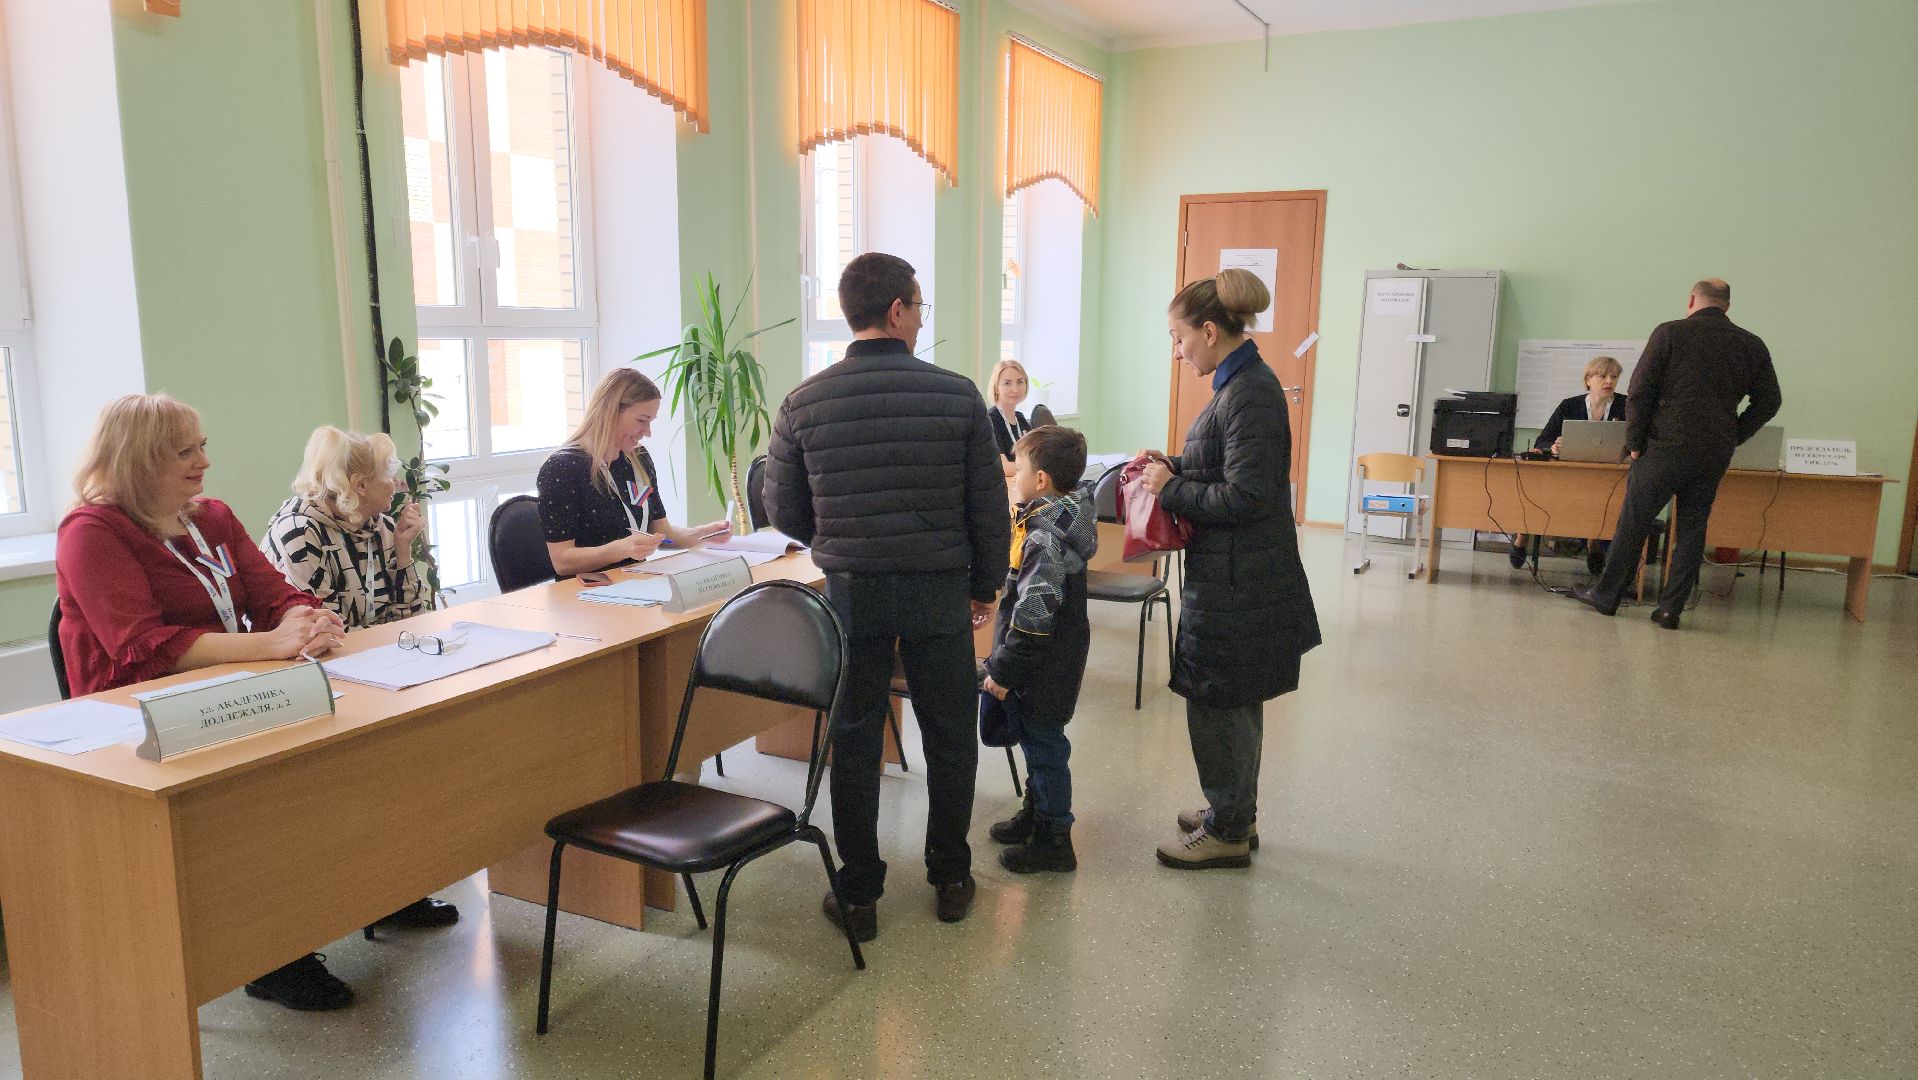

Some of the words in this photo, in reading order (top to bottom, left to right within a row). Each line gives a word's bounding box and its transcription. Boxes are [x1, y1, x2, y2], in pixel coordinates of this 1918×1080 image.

[217, 689, 286, 711] АКАДЕМИКА
[200, 703, 275, 729] ДОЛЛЕЖАЛЯ,
[285, 699, 292, 707] 2
